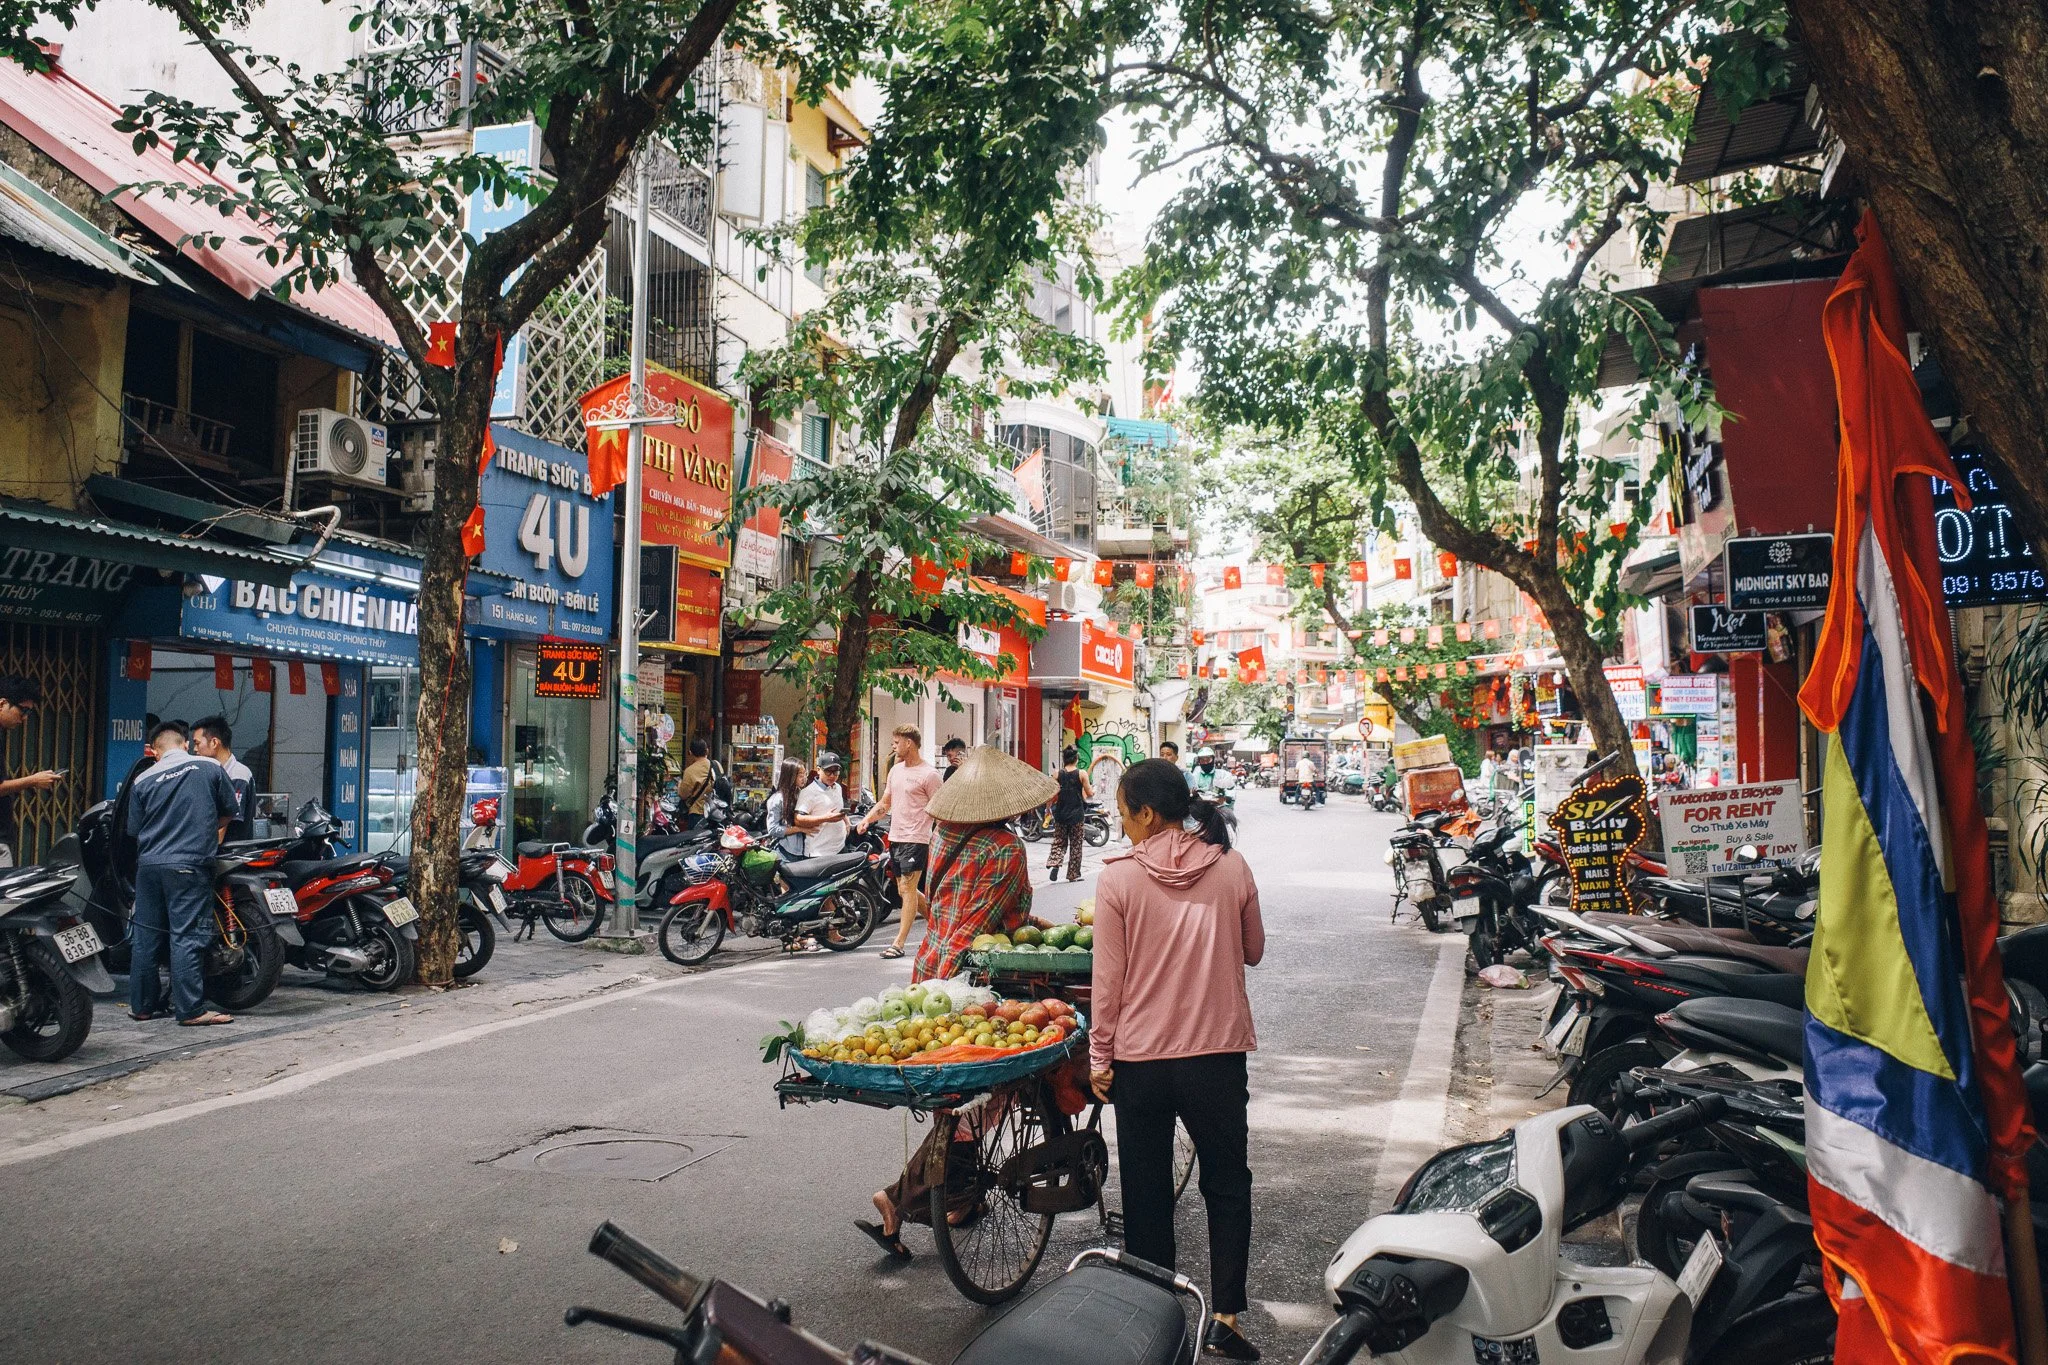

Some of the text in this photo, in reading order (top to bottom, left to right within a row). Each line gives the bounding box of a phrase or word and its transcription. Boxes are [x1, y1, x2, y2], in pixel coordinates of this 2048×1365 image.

[497, 444, 547, 482] TRANG
[551, 461, 579, 491] SỨC
[643, 435, 729, 492] THỊ VÀNG
[518, 493, 590, 579] 4U
[0, 546, 135, 593] TRANG
[529, 582, 559, 605] BUÔN
[1735, 572, 1829, 592] MIDNIGHT SKY BAR
[303, 585, 387, 630] CHIẾN
[1764, 596, 1780, 604] 096
[491, 603, 538, 626] 151 HÀNG BẠC
[266, 621, 299, 637] CHUYÊN
[300, 627, 326, 641] TRANG
[343, 634, 368, 647] PHONG
[542, 649, 598, 662] TRANG SỨC BẠC
[553, 661, 586, 682] 4U
[1685, 695, 1715, 703] EXCHANGE
[111, 718, 143, 742] TRANG
[341, 781, 355, 804] LÀM
[1669, 785, 1784, 806] Motorbike & Bicycle
[1683, 800, 1777, 824] FOR RENT
[1690, 818, 1770, 834] Cho Thuê Xe Máy
[1726, 831, 1774, 844] Buy & Sale
[1585, 868, 1610, 879] NAILS
